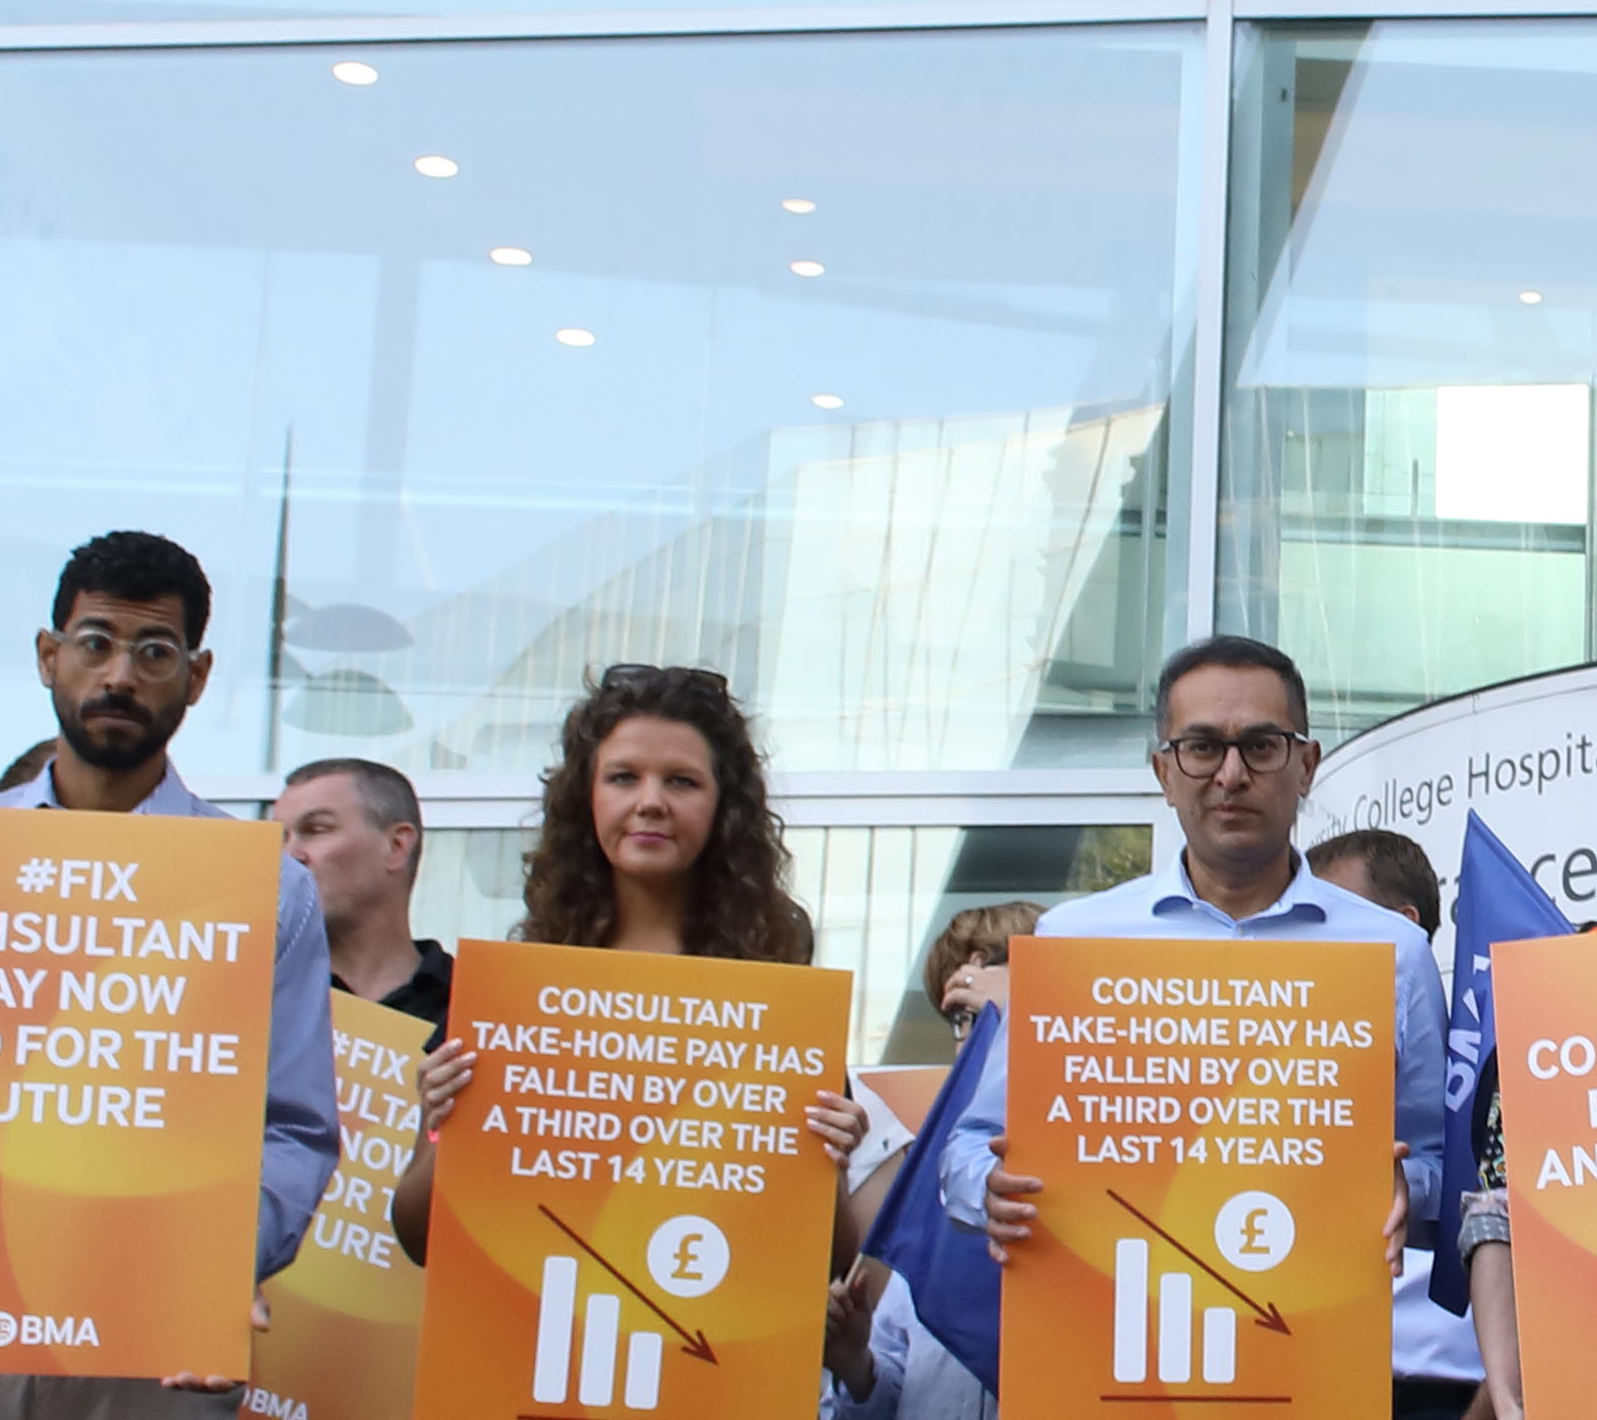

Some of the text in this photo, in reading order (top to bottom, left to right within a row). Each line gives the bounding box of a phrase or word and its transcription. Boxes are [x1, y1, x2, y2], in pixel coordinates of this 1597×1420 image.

[1353, 772, 1454, 830] College
[15, 857, 140, 903] #FIX
[58, 970, 188, 1016] NOW
[538, 986, 768, 1029] CONSULTANT
[1092, 977, 1315, 1007] CONSULTANT
[15, 1024, 124, 1069] FOR
[134, 1029, 240, 1075] THE
[472, 1021, 824, 1076] TAKE-HOME PAY HAS
[1030, 1015, 1373, 1048] TAKE-HOME PAY HAS
[504, 1064, 787, 1113] FALLEN BY OVER
[1064, 1055, 1339, 1086] FALLEN BY OVER
[482, 1105, 799, 1155] A THIRD OVER THE
[1047, 1095, 1353, 1127] A THIRD OVER THE
[511, 1147, 765, 1193] LAST 14 YEARS
[1078, 1134, 1324, 1166] LAST 14 YEARS
[321, 1170, 373, 1213] OR
[314, 1213, 396, 1269] URE
[20, 1315, 100, 1346] BMA
